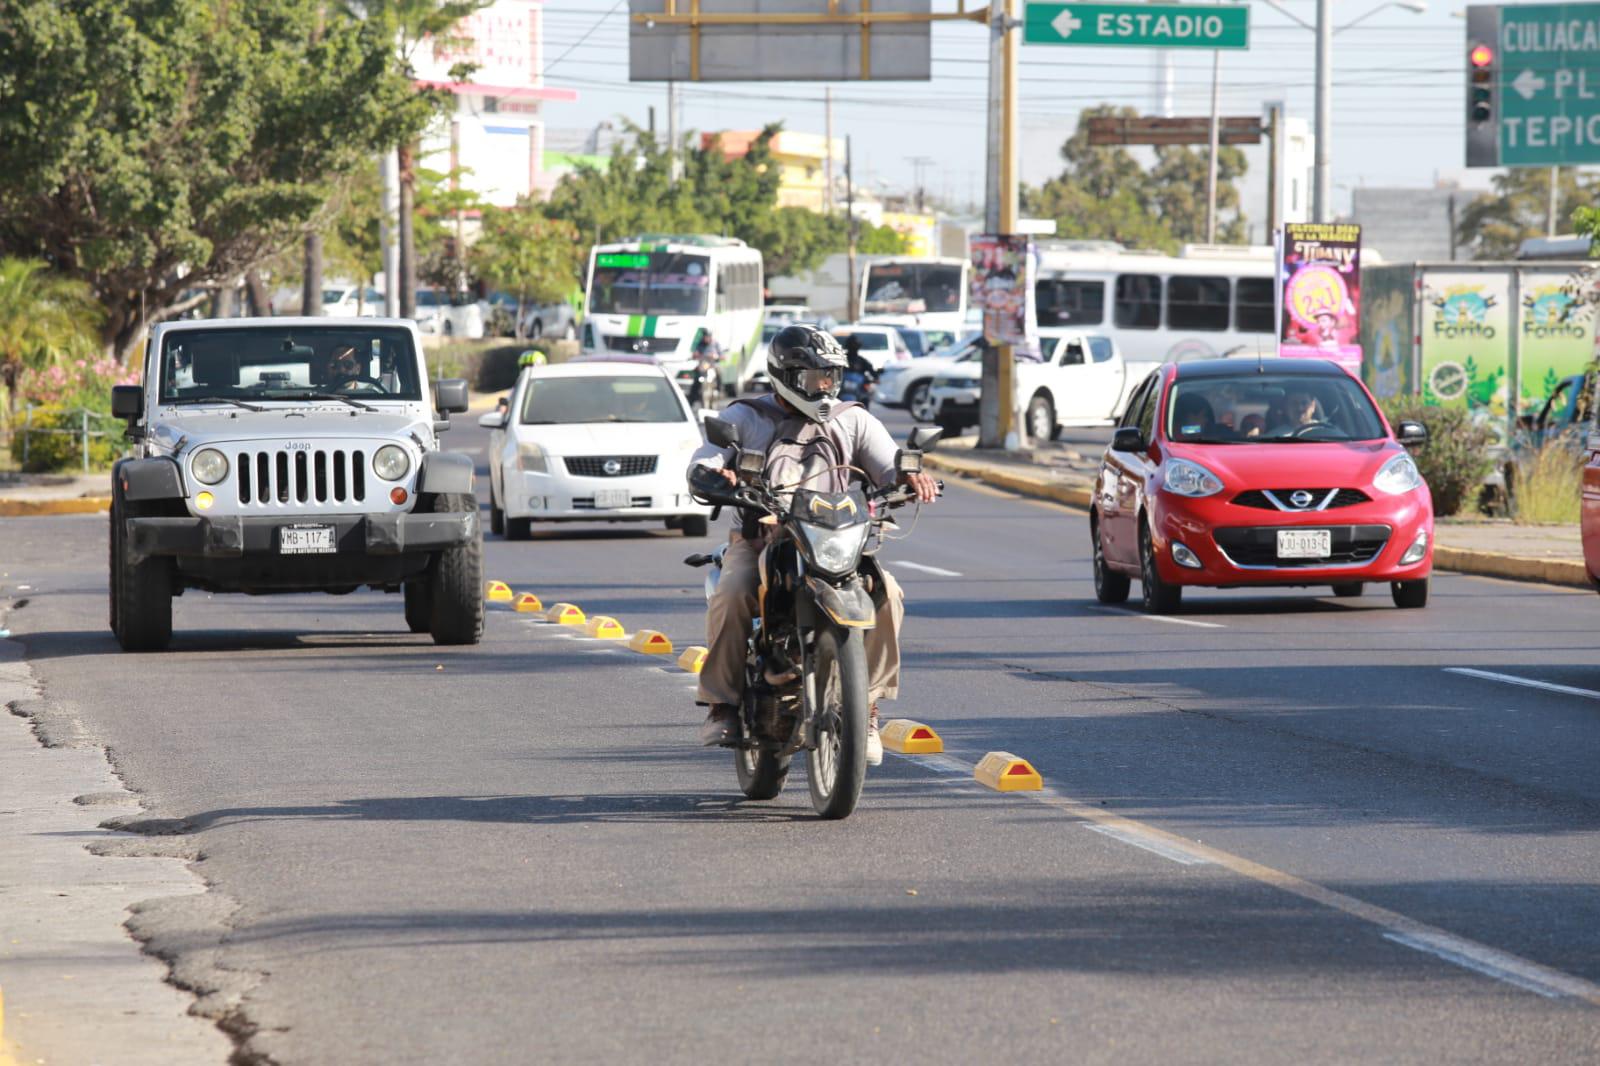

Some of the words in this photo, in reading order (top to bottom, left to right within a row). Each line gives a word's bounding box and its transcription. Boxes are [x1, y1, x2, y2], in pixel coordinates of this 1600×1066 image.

[1097, 13, 1223, 38] ESTADIO
[1504, 20, 1600, 52] CULIACA
[1434, 321, 1496, 339] Farito
[1523, 321, 1585, 339] Farito
[285, 441, 311, 451] Jeep
